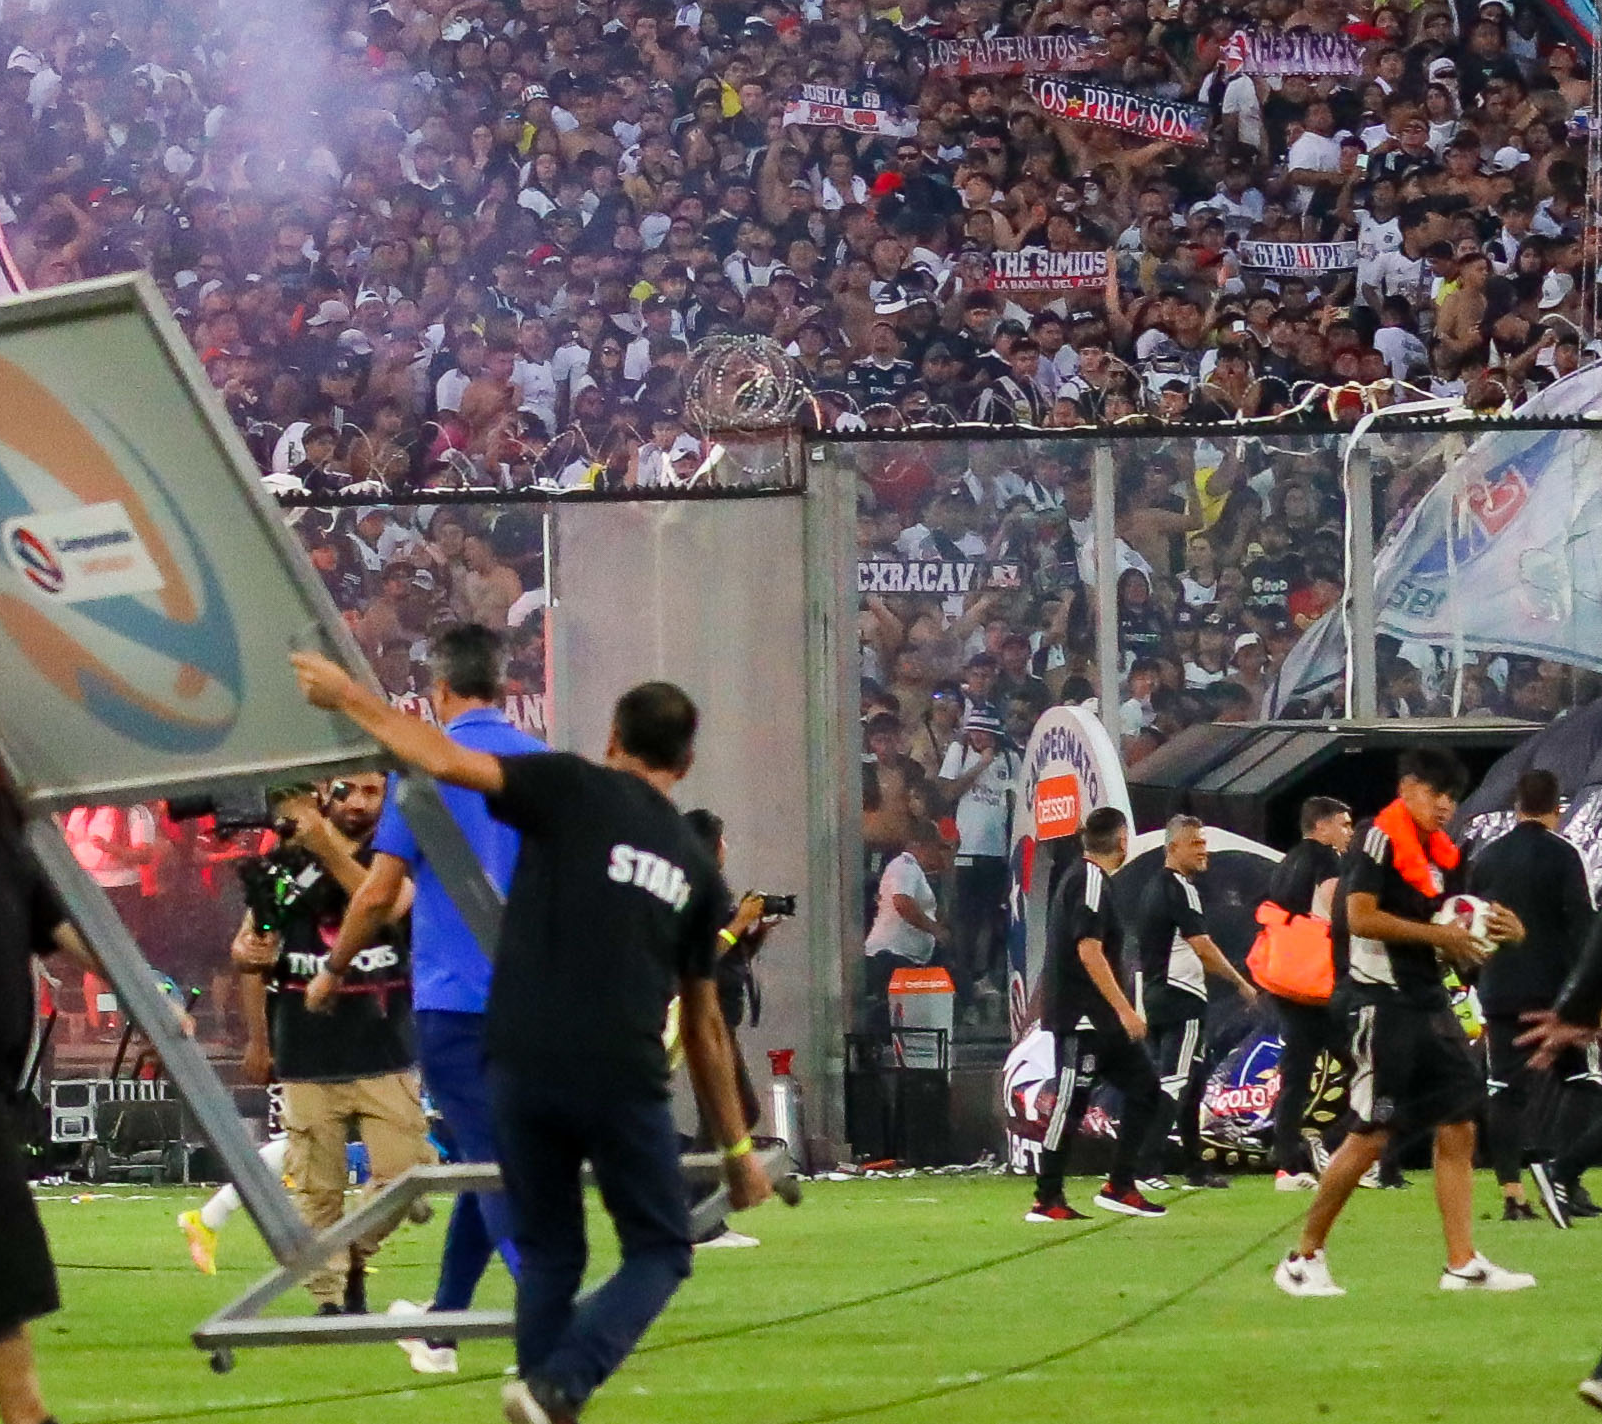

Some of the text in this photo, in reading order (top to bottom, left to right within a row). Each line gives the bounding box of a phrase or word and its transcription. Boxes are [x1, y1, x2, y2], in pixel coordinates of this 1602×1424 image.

[1027, 77, 1067, 113] LOS
[991, 249, 1107, 278] THE SIMIOS
